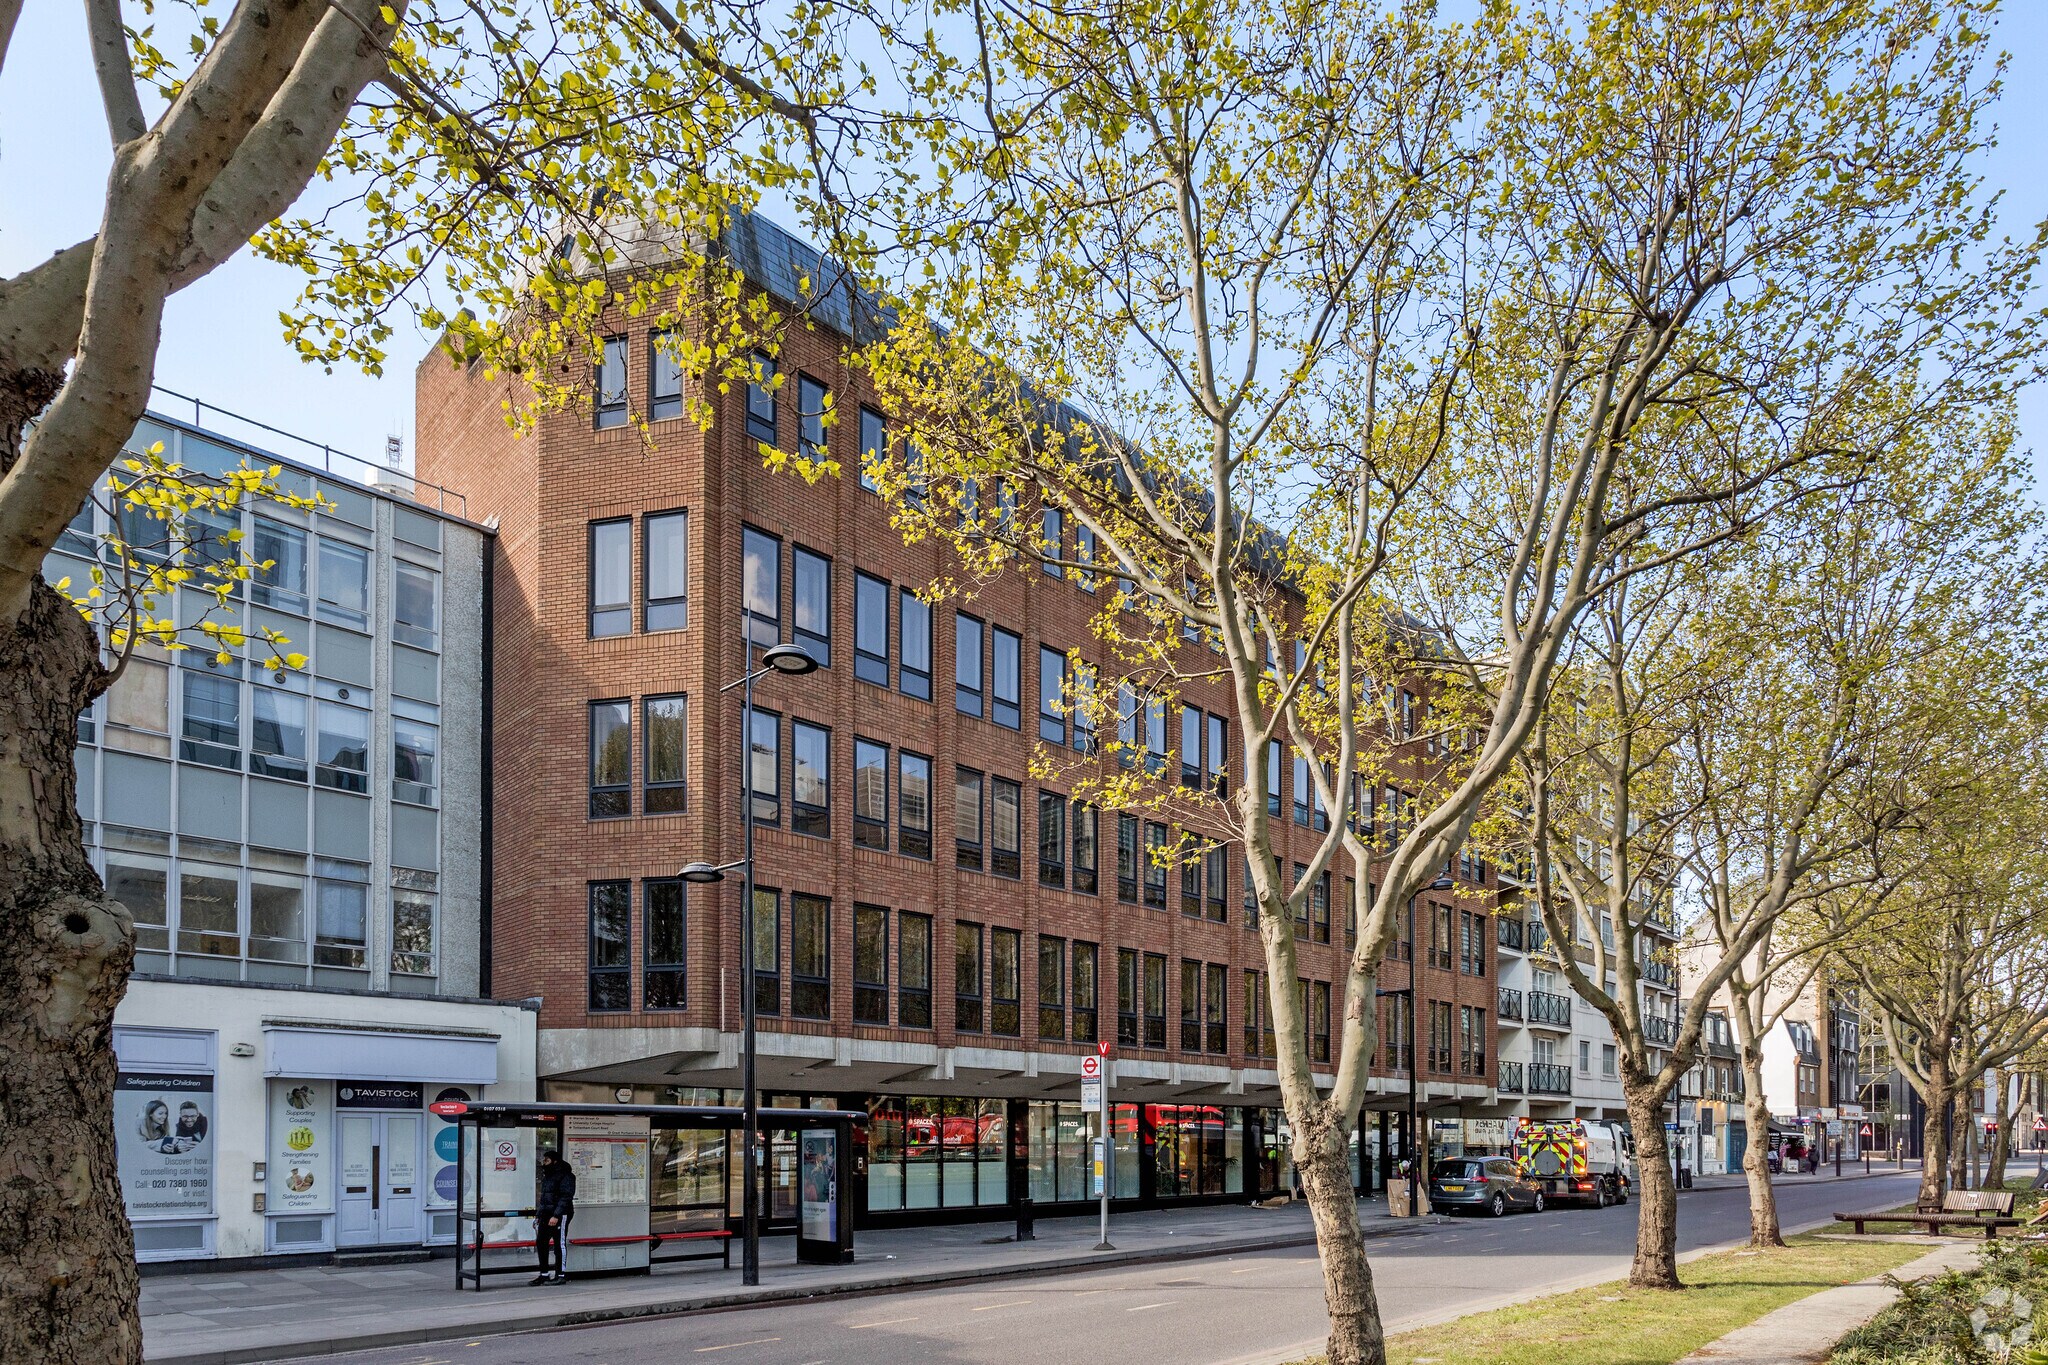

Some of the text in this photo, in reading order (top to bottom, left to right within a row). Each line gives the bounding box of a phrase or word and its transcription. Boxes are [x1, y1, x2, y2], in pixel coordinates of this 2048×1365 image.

[1100, 1043, 1107, 1054] V
[126, 1078, 171, 1086] Safeguarding
[355, 1089, 418, 1098] TAVISTOCK
[141, 1168, 177, 1176] counselling
[194, 1167, 207, 1176] help
[152, 1180, 166, 1188] 020
[169, 1180, 188, 1188] 7380
[190, 1179, 208, 1187] 1960
[132, 1200, 208, 1209] tavistockrelationships.org
